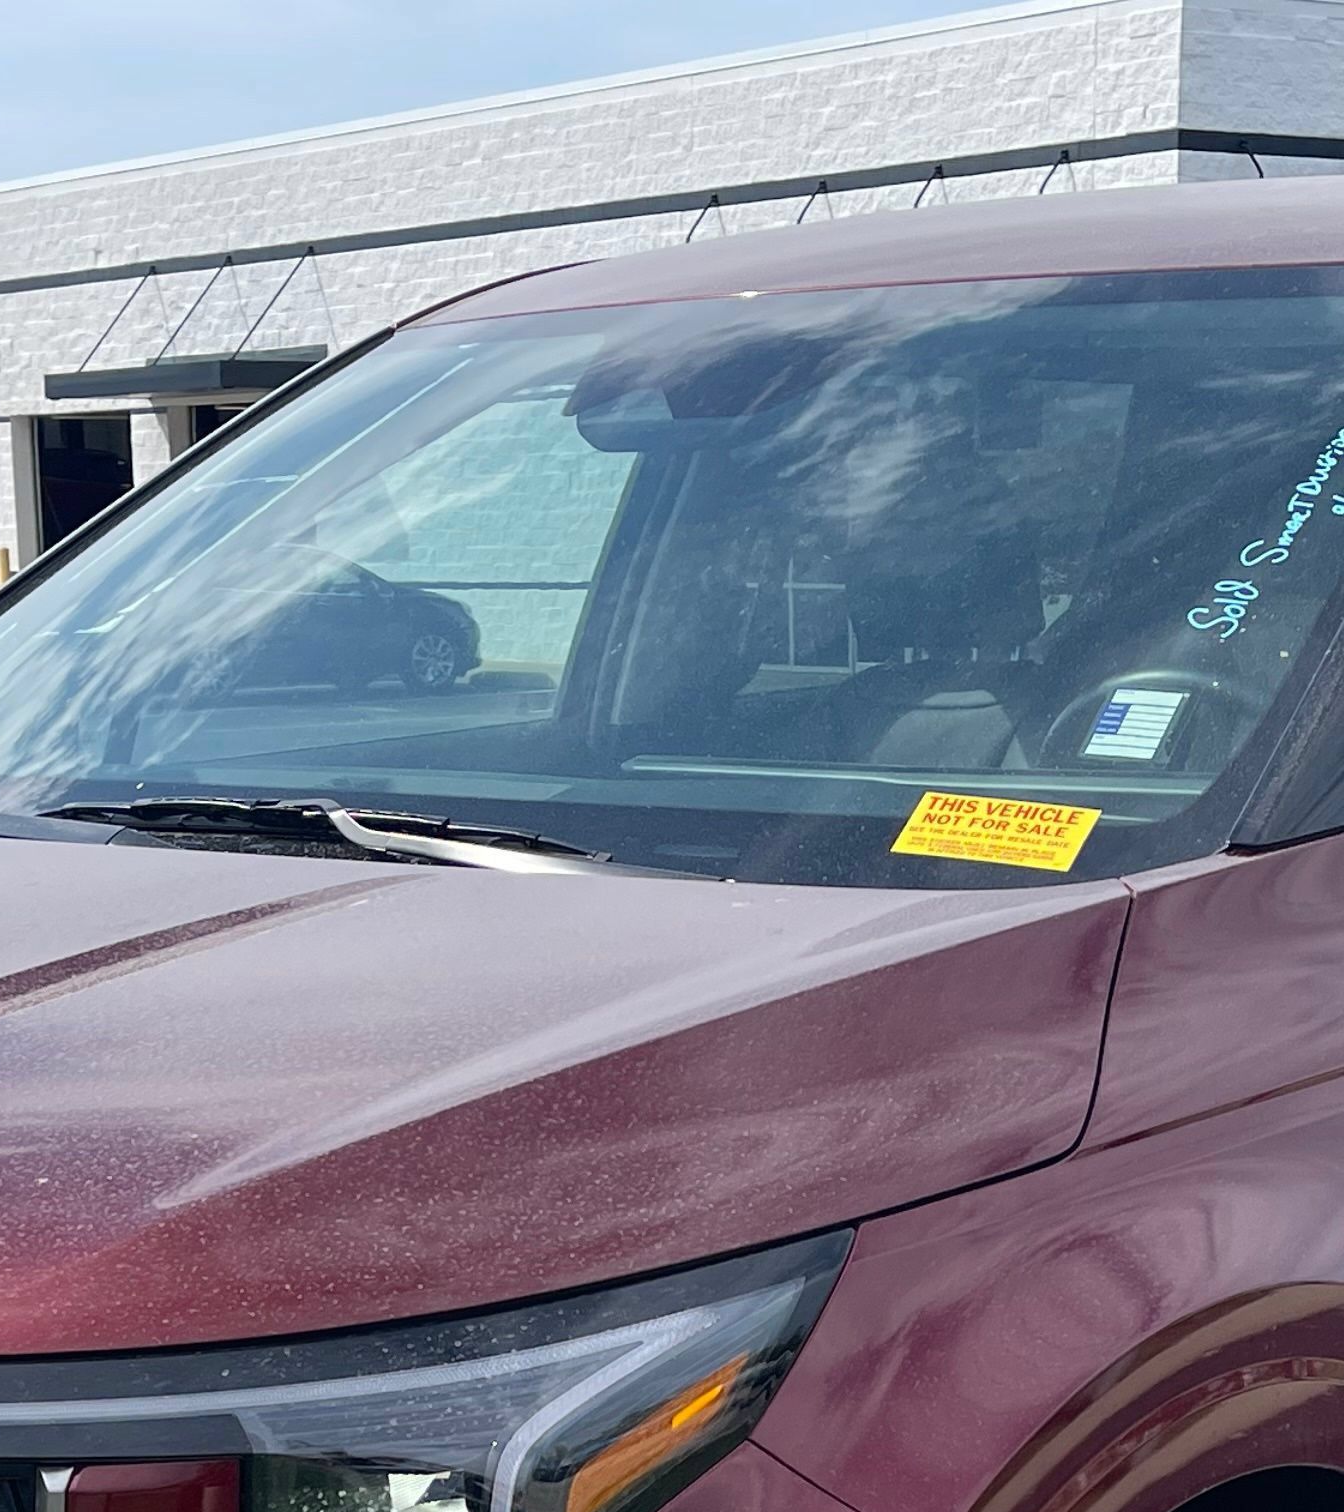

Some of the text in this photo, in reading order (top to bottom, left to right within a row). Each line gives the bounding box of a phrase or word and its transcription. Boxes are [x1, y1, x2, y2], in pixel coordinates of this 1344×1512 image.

[1187, 580, 1259, 639] Sold
[928, 796, 1085, 825] THIS VEHICLE
[922, 813, 1070, 838] NOT FOR SALE
